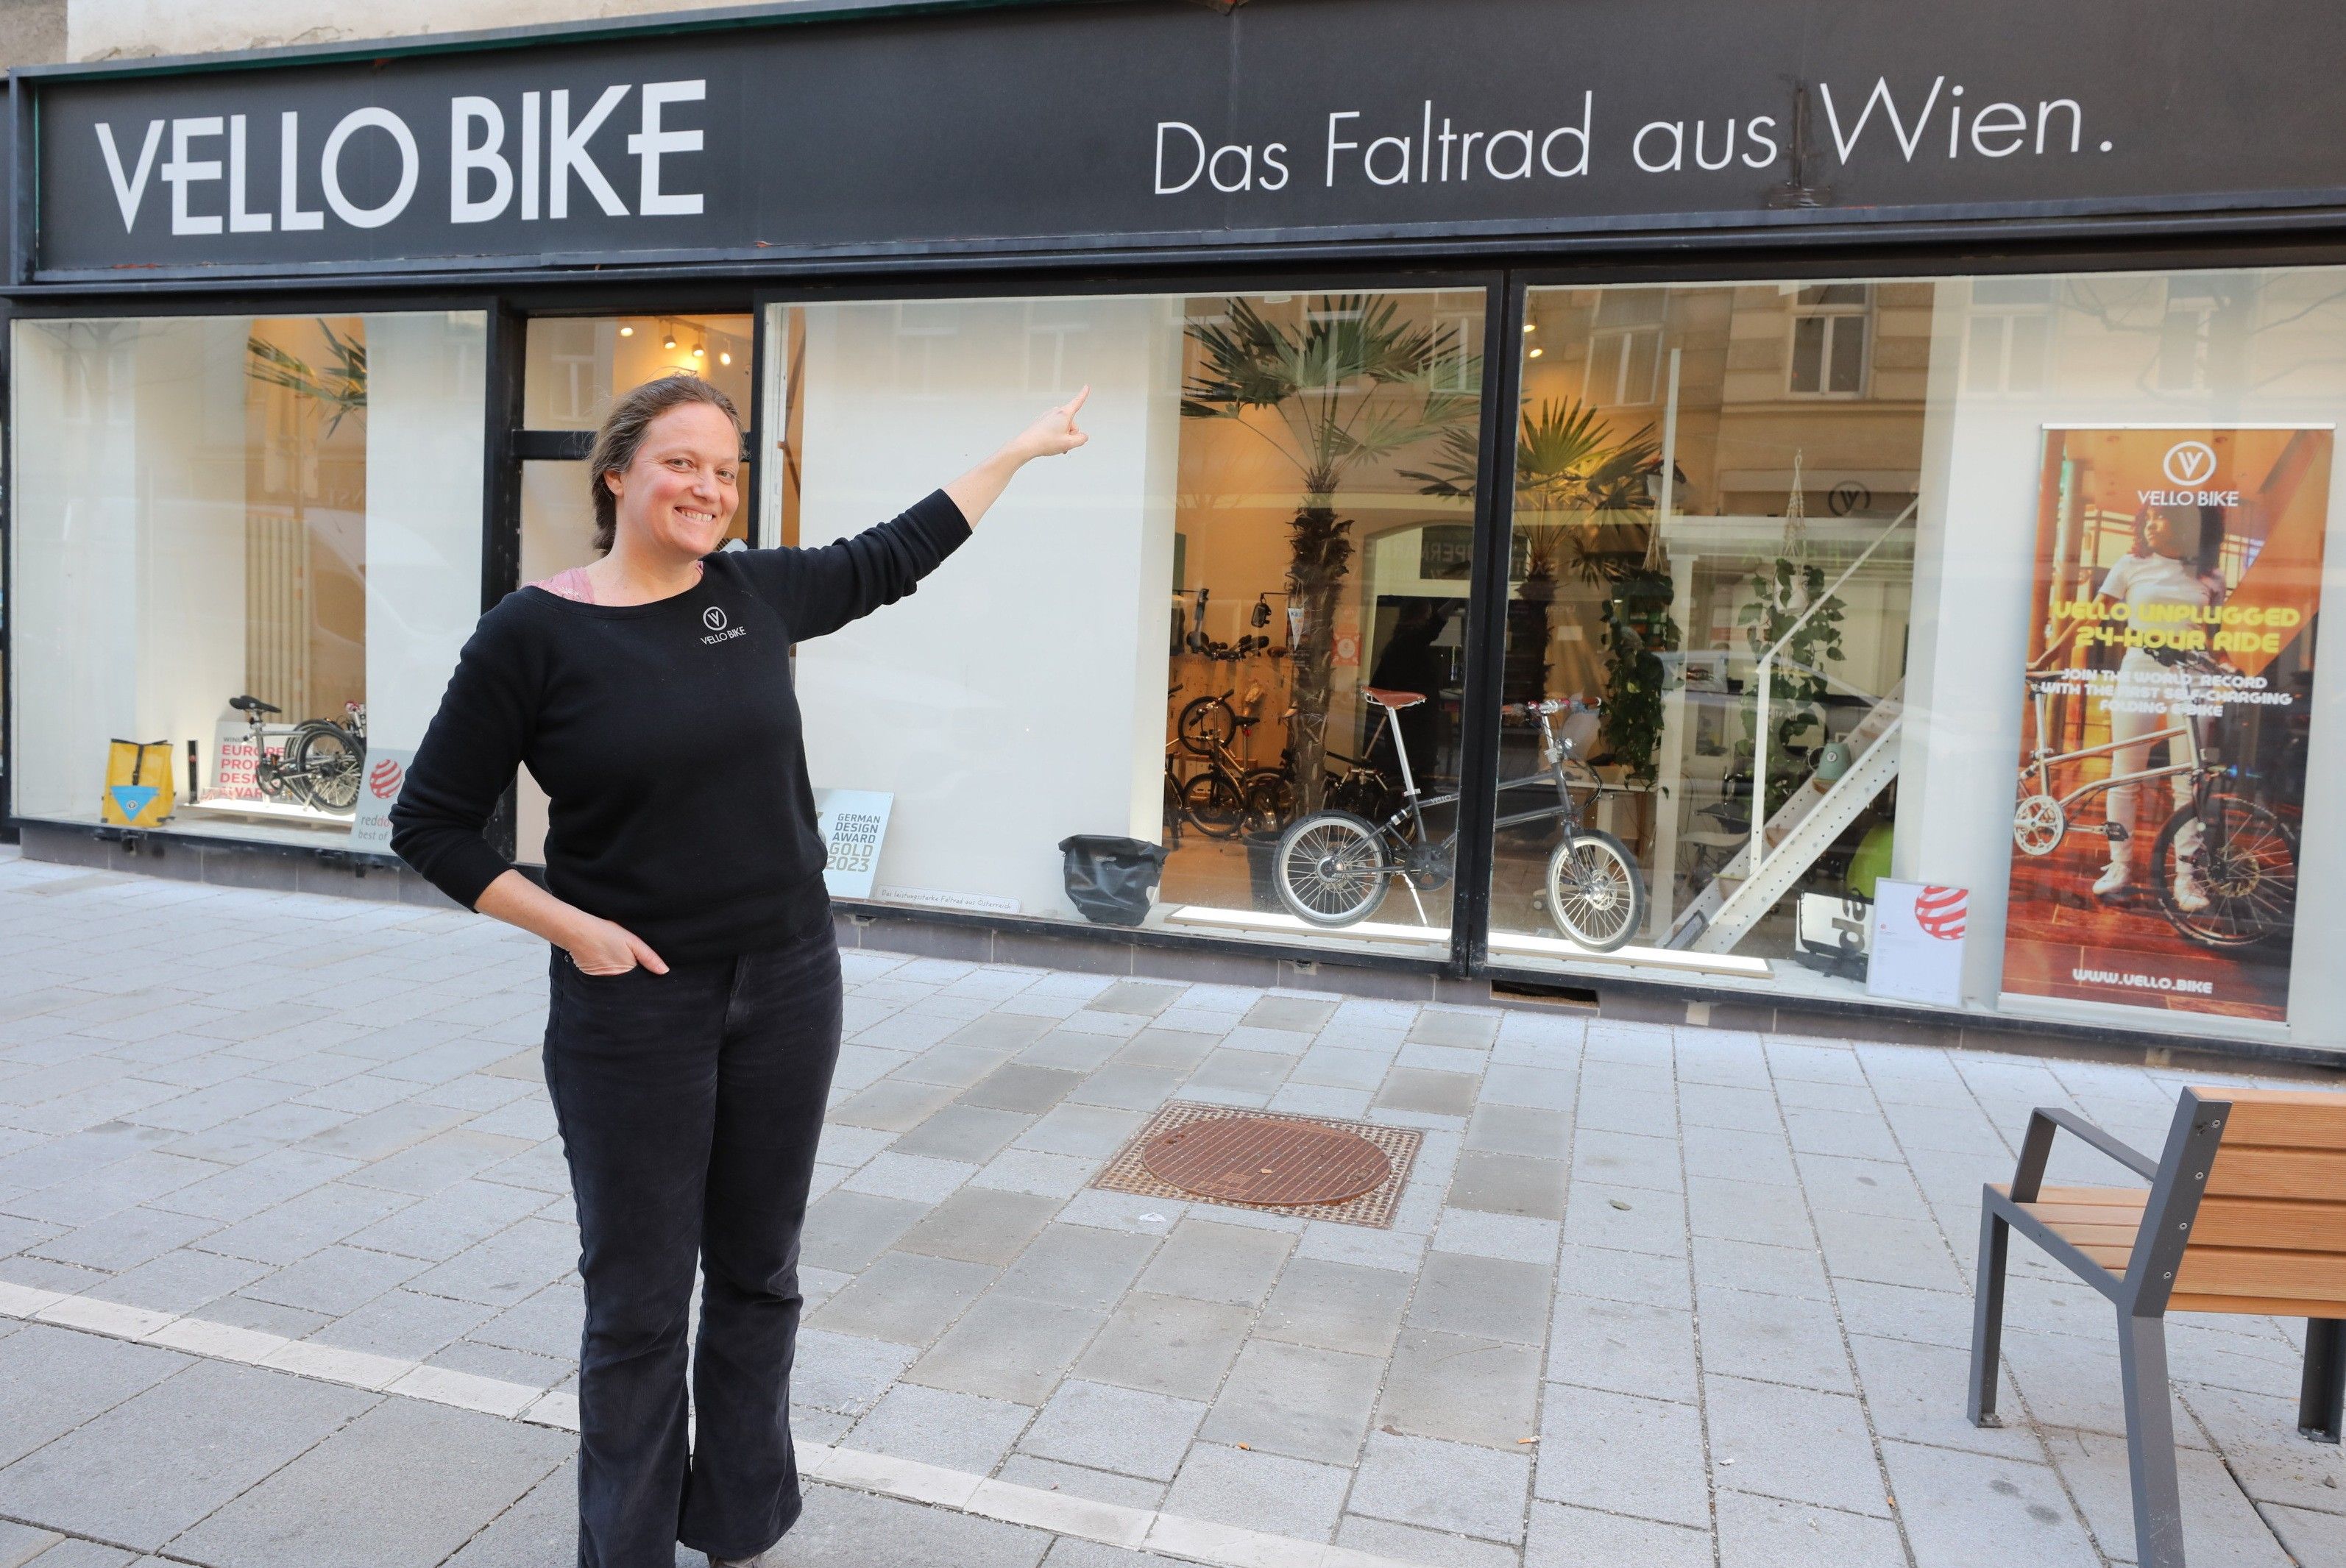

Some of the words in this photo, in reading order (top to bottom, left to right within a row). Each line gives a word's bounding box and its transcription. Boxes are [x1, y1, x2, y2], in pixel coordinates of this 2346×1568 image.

[1155, 122, 1289, 194] Das
[1326, 90, 1592, 187] Faltrad
[1633, 116, 1778, 172] aus
[1819, 75, 2113, 166] Wien.
[95, 107, 419, 235] VELLO
[450, 79, 706, 224] BIKE
[2137, 489, 2194, 506] VELLO
[2197, 490, 2239, 507] BIKE
[2052, 600, 2131, 622] VELLO
[2138, 603, 2300, 628] UNPLUGGED
[700, 632, 728, 645] VELLO
[726, 625, 746, 639] BIKE
[2075, 625, 2206, 651] 24-HOUR
[2213, 631, 2281, 653] RIDE
[2061, 668, 2097, 681] JOIN
[2102, 670, 2131, 683] THE
[2134, 671, 2191, 686] WORLD
[2200, 673, 2268, 689] RECORD
[2041, 681, 2081, 695] WITH
[2085, 684, 2114, 697] THE
[1430, 795, 1451, 803] VELLO
[837, 813, 881, 823] GERMAN
[358, 829, 376, 840] best
[378, 831, 389, 841] of
[834, 822, 879, 833] DESIGN
[832, 831, 876, 844] AWARD
[829, 842, 873, 857] GOLD
[825, 855, 871, 873] 2023
[941, 895, 963, 905] Faltrad
[977, 897, 1011, 909] Österreich
